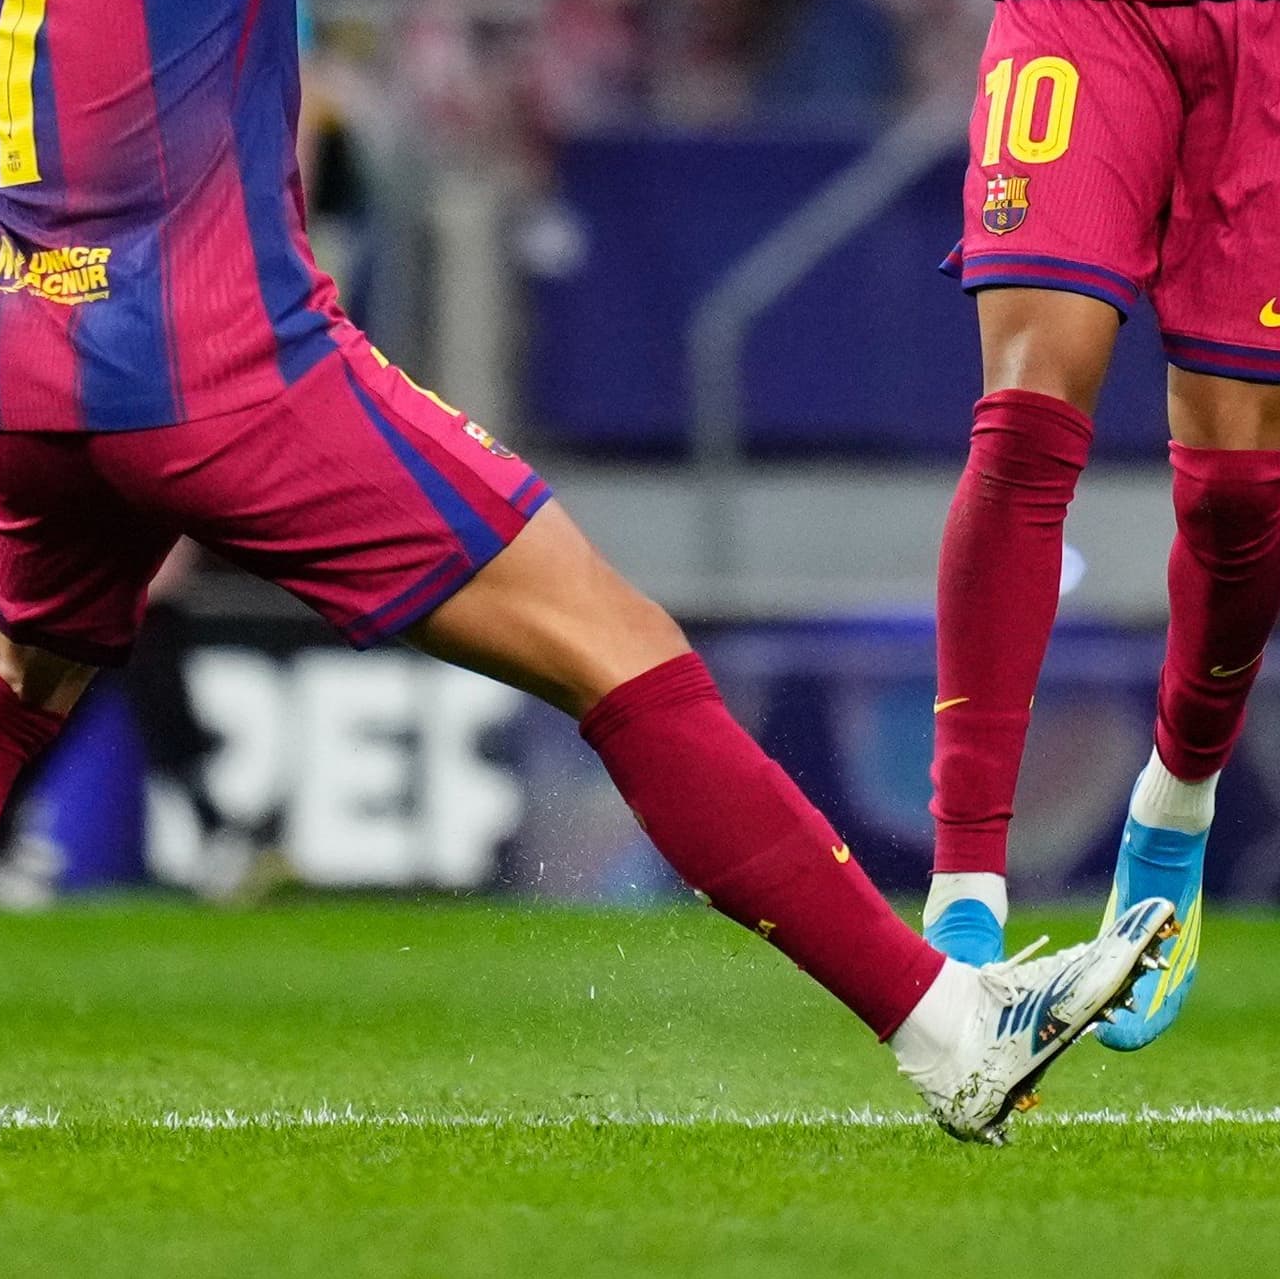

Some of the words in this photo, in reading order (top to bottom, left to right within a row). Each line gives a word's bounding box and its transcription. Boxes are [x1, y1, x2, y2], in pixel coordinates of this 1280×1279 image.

[981, 56, 1080, 167] 10
[28, 246, 112, 274] UNHCR
[23, 264, 109, 295] ACNUR
